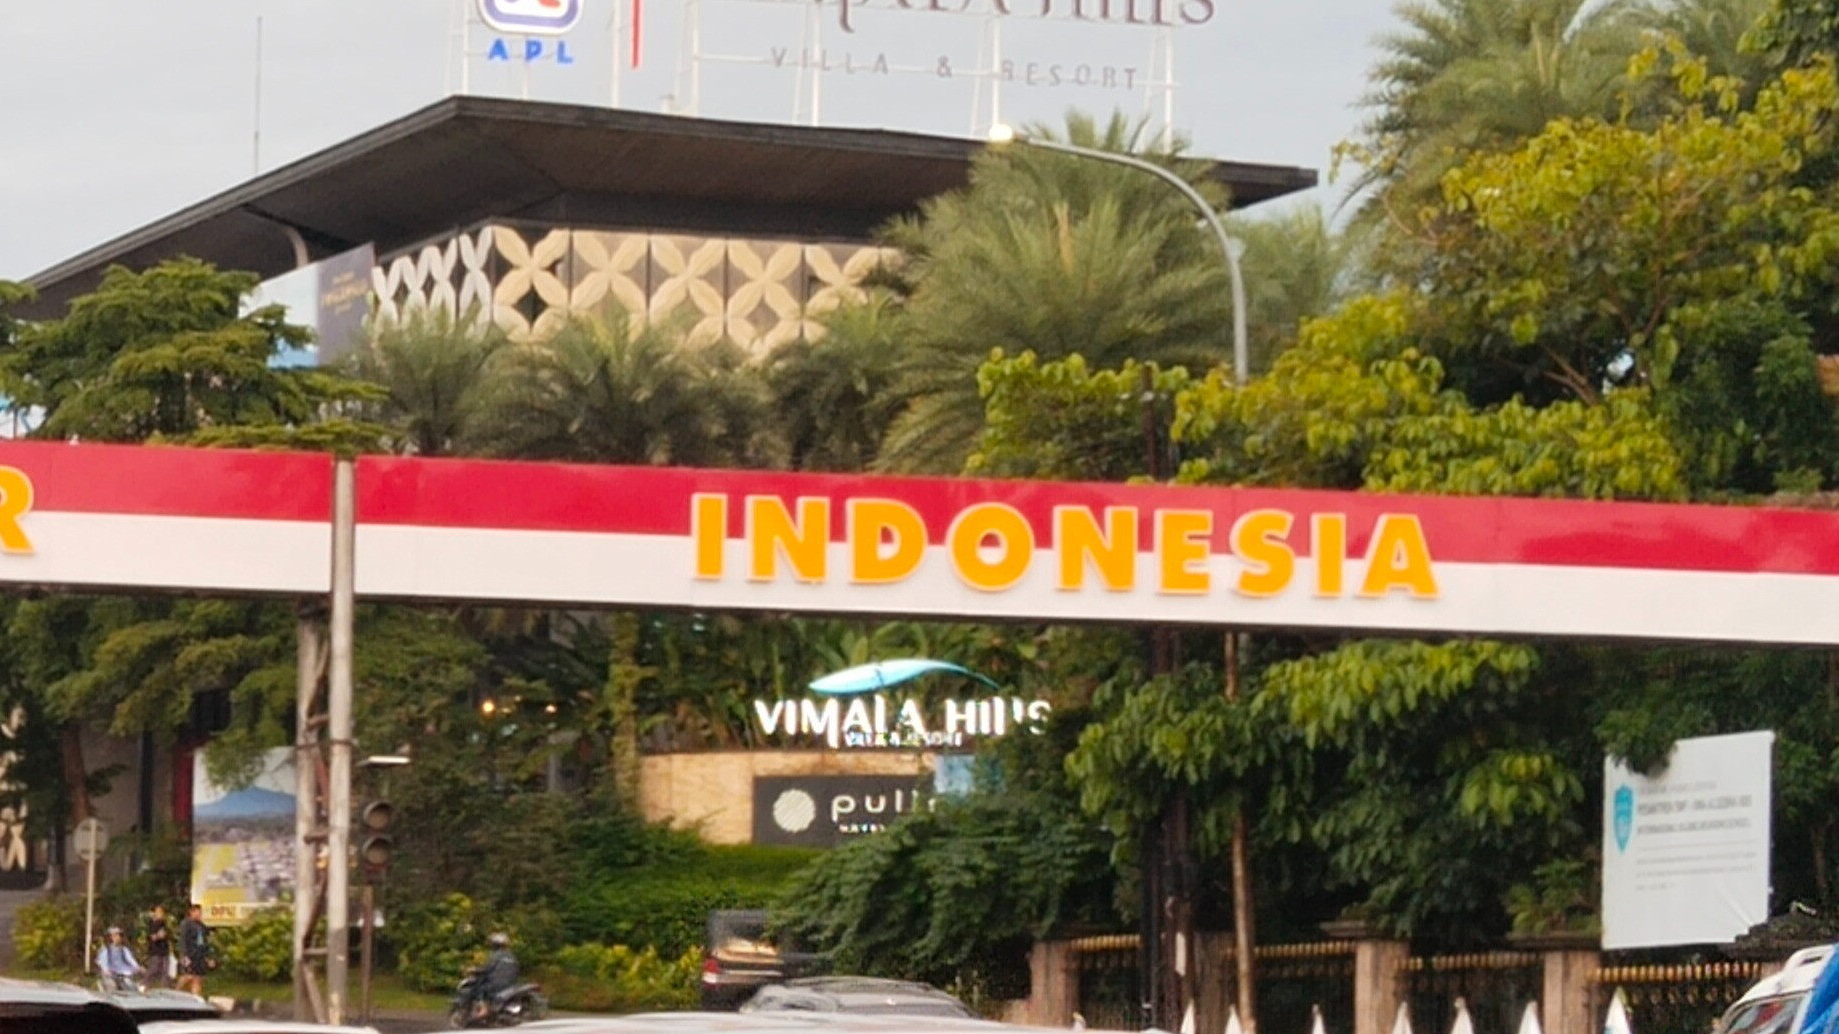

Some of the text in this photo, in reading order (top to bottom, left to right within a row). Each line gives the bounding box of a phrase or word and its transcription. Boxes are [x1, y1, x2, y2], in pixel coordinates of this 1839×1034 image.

[487, 37, 573, 64] APL
[770, 47, 1137, 91] VILLA & RESORT
[691, 491, 1441, 599] INDONESIA
